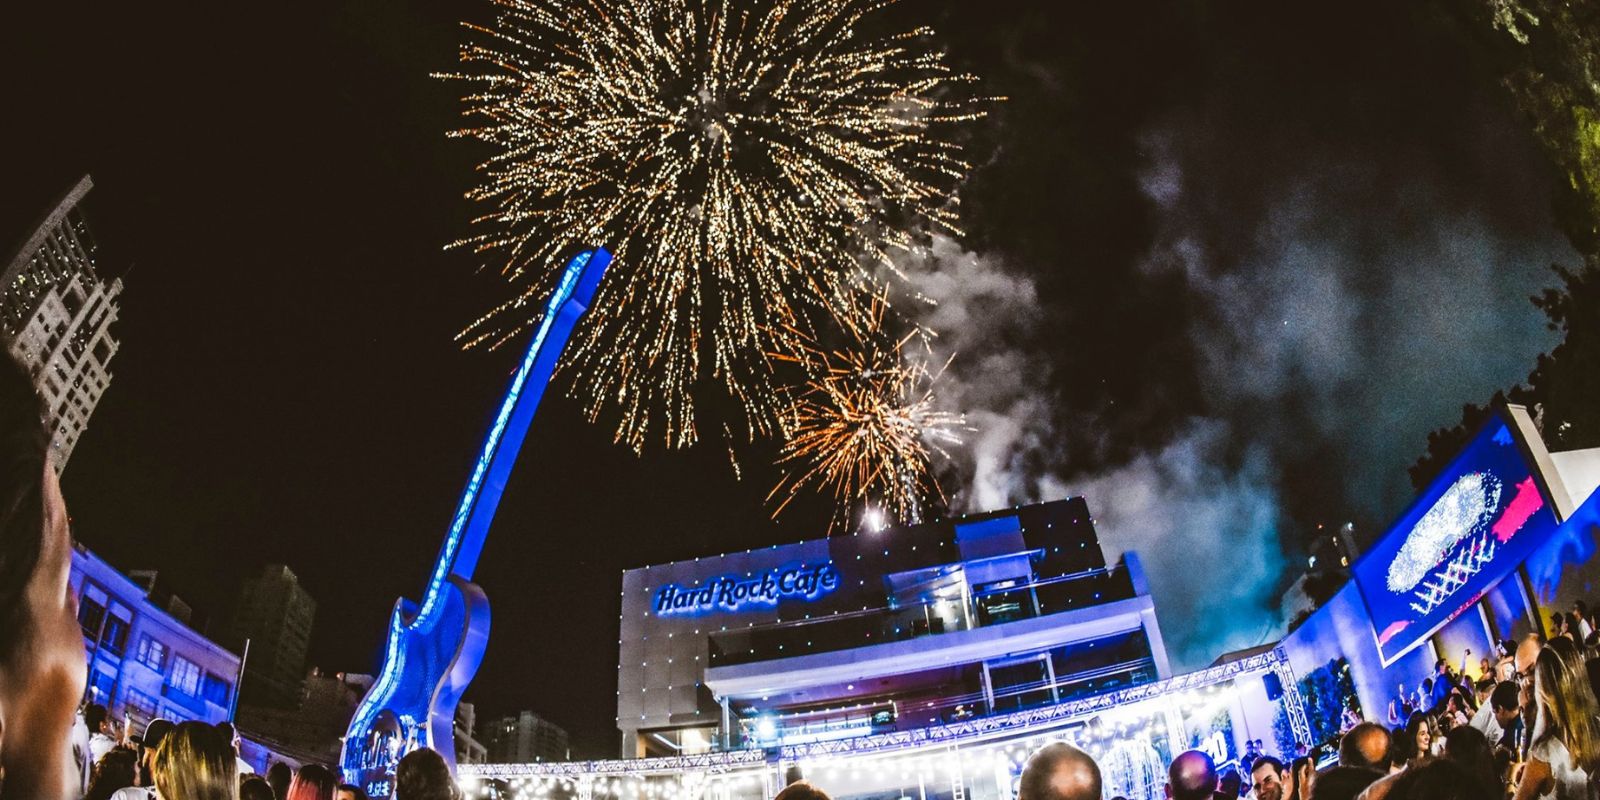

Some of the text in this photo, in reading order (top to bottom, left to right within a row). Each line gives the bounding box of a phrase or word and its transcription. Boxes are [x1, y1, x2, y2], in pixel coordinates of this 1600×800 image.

[657, 564, 835, 612] Hard Rock Cafe
